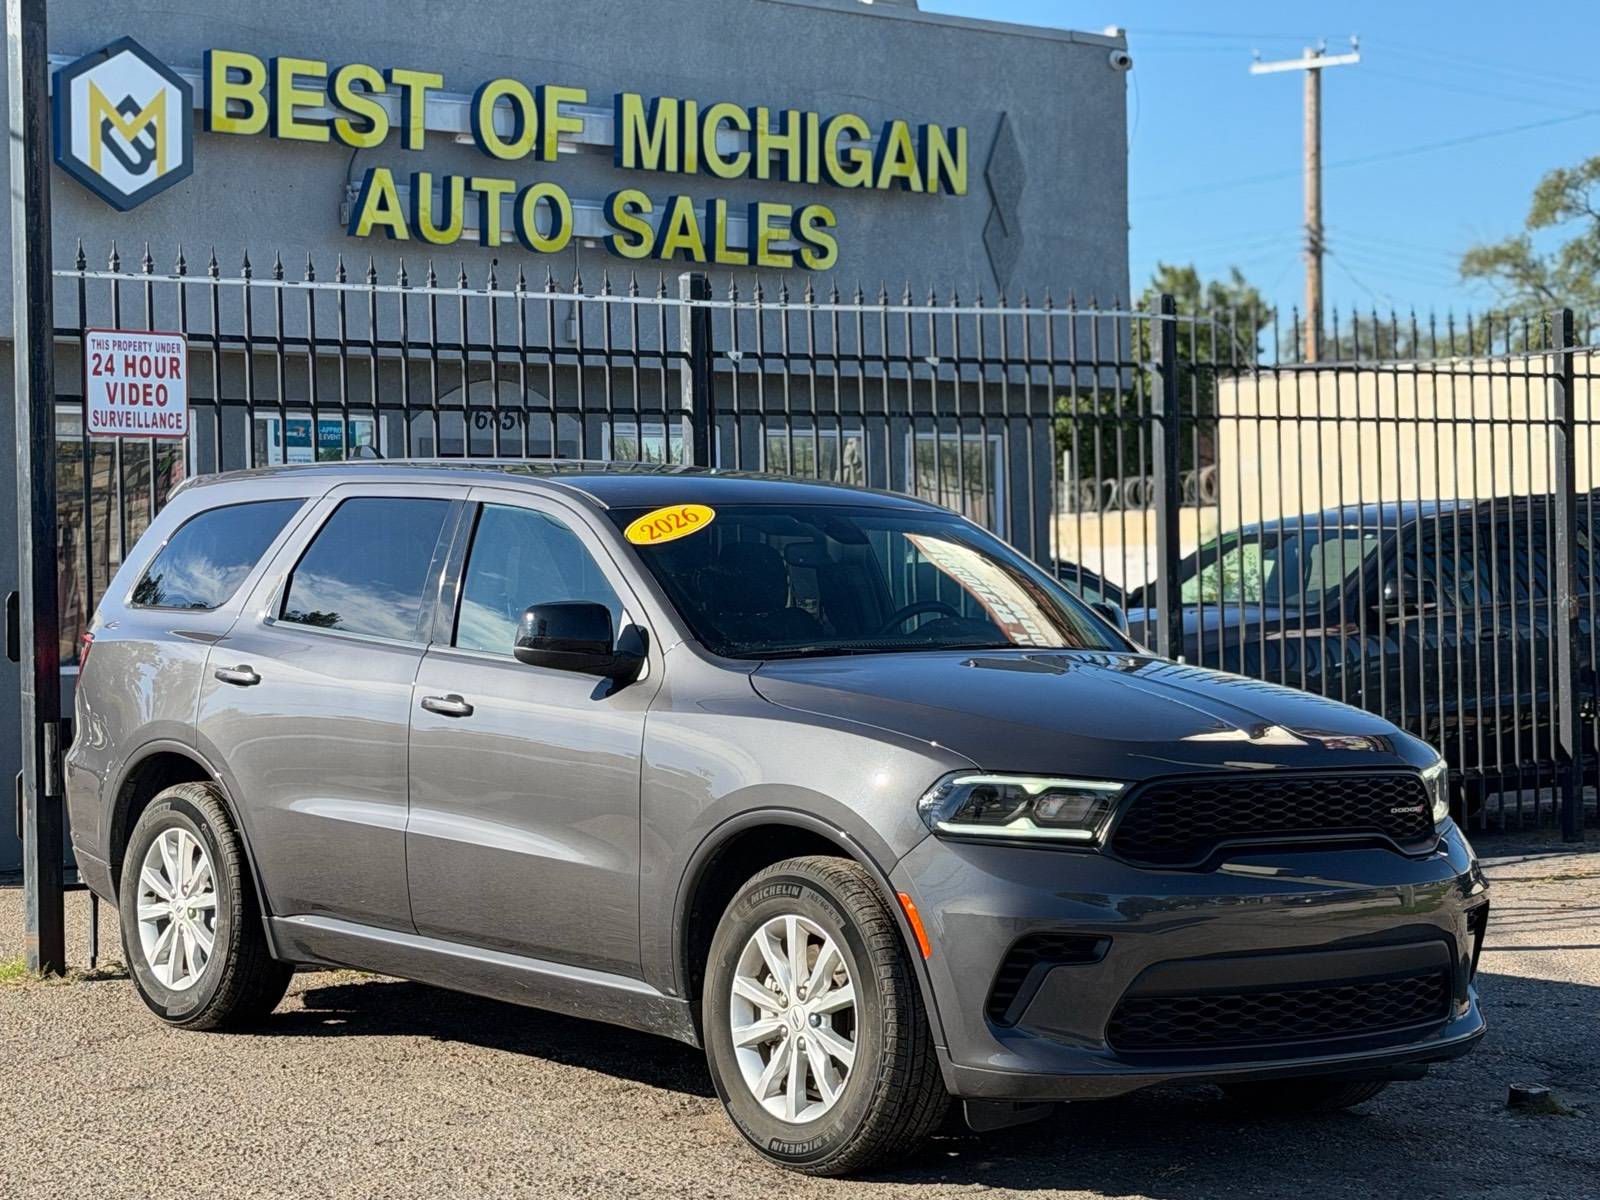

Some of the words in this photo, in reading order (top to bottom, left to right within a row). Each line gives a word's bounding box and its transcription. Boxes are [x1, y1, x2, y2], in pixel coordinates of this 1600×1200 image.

[207, 49, 444, 151] BEST
[475, 78, 588, 162] OF
[617, 92, 968, 196] MICHIGAN
[351, 167, 574, 254] AUTO
[608, 188, 839, 271] SALES
[91, 338, 110, 351] THIS
[112, 340, 153, 353] PROPERTY
[155, 342, 181, 354] UNDER
[92, 352, 115, 377] 24
[124, 354, 181, 380] HOUR
[105, 381, 169, 407] VIDEO
[92, 409, 183, 430] SURVEILLANCE
[640, 507, 700, 541] 2026
[750, 884, 801, 904] MICHELIN
[770, 1136, 823, 1152] MICHELIN
